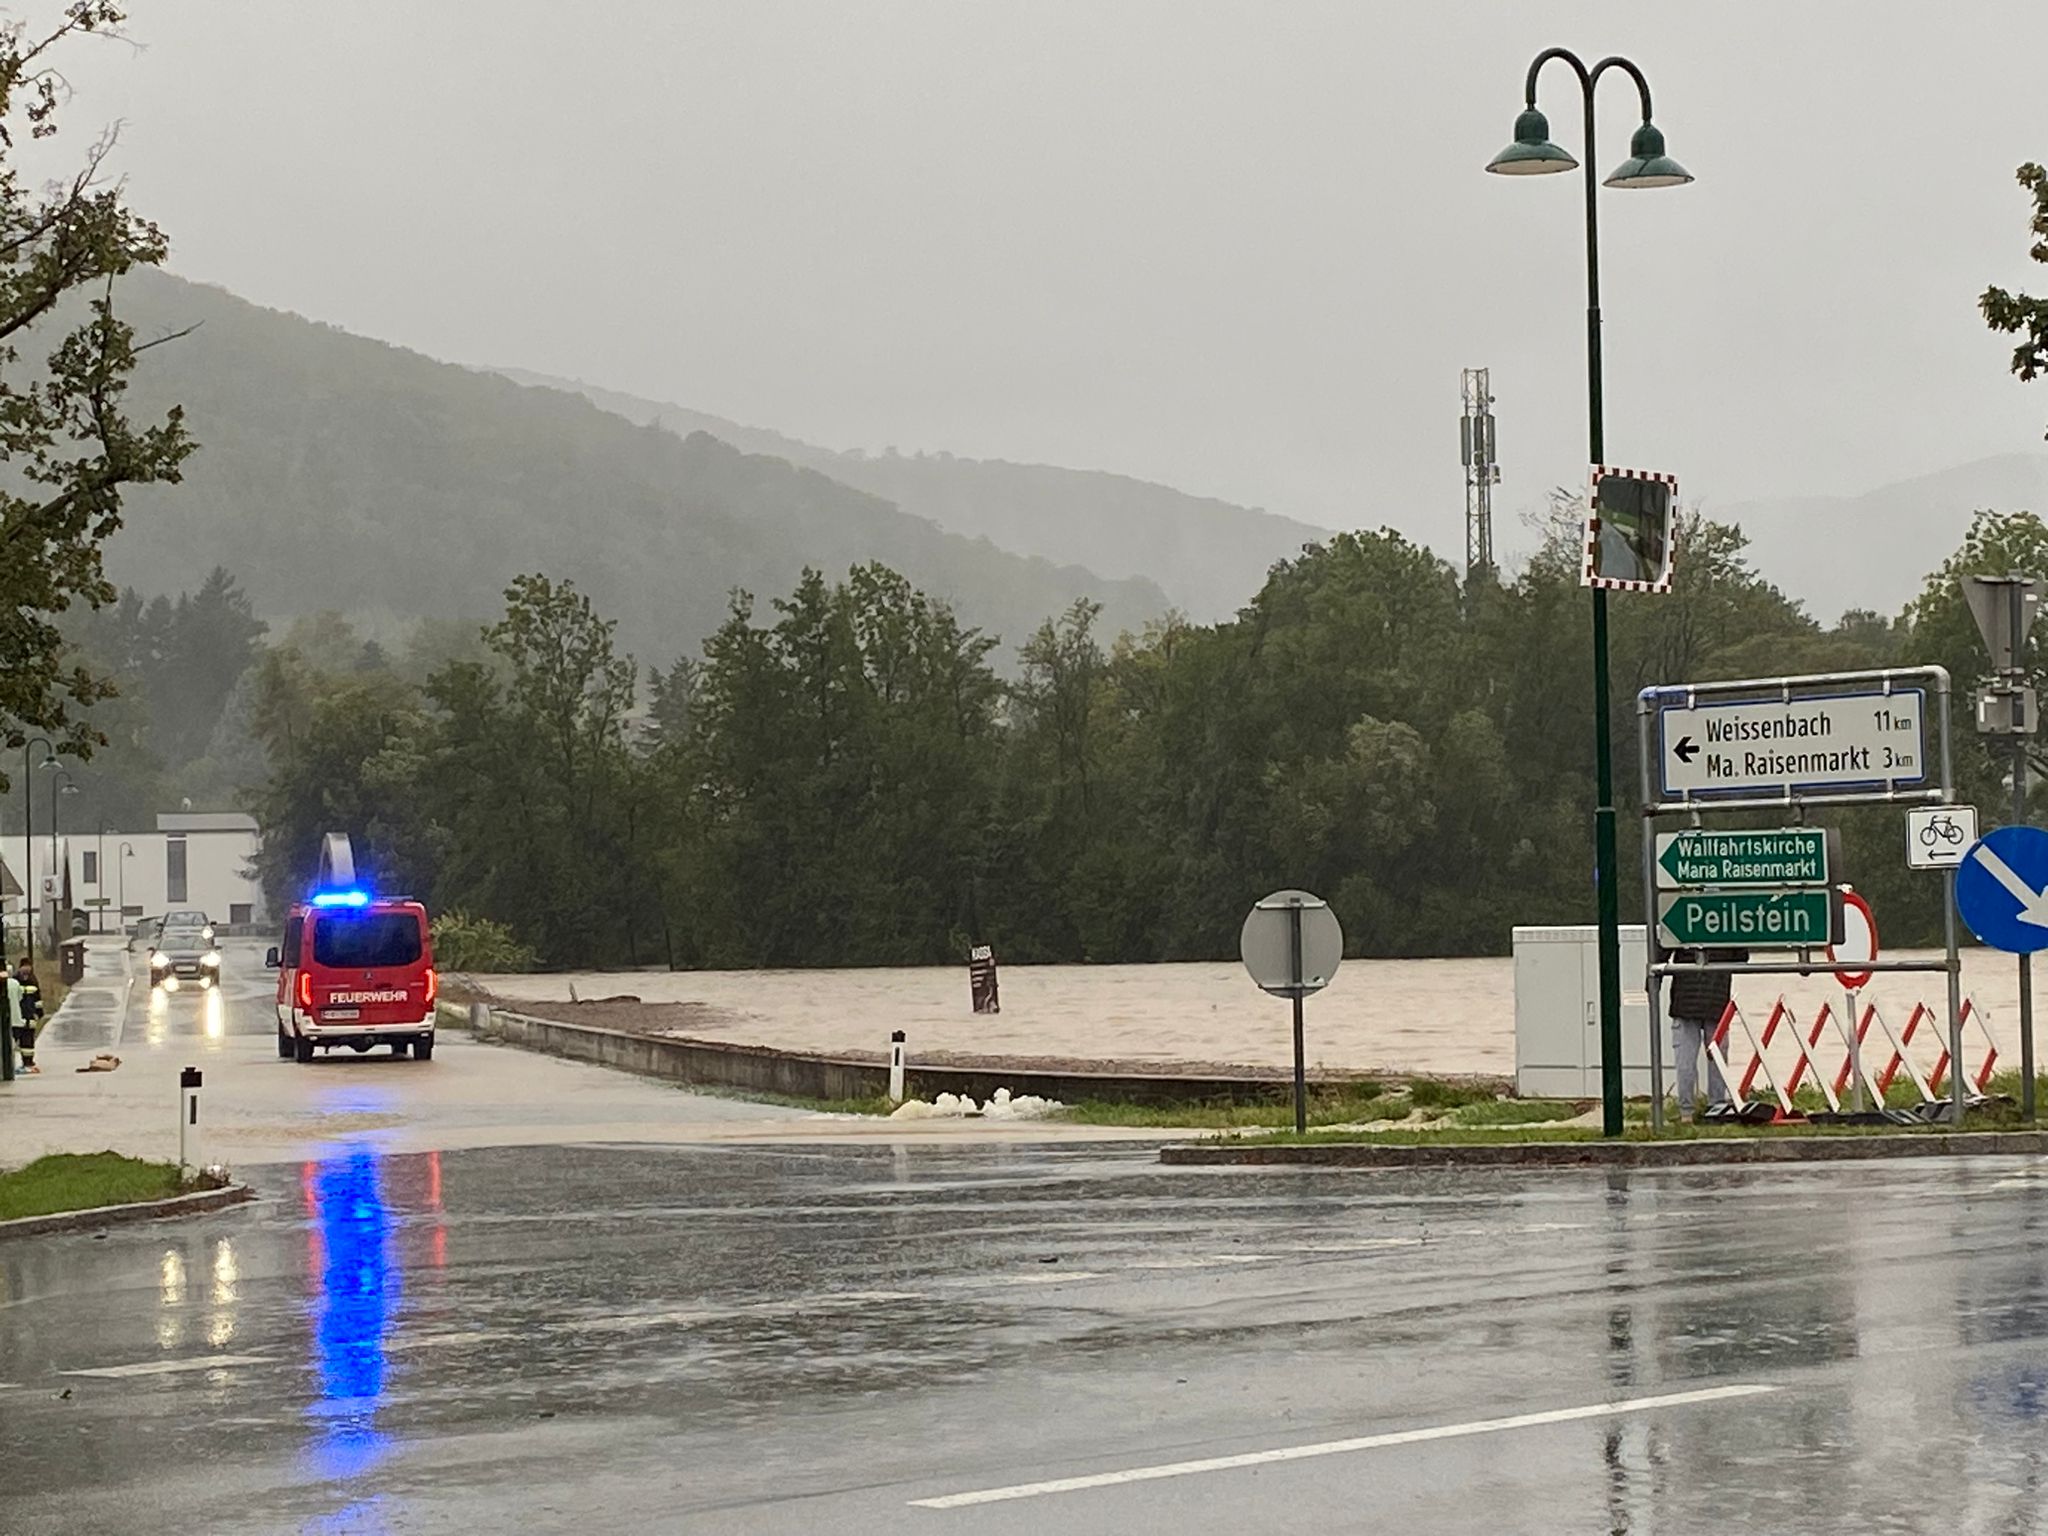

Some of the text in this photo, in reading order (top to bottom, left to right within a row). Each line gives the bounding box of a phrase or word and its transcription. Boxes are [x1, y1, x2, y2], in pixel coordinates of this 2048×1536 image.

[1707, 710, 1912, 742] Weissenbach 11 km
[1707, 745, 1913, 778] Ma. Raisenmarkt 3 km
[1678, 836, 1816, 857] Wallfahrtskirche
[1678, 858, 1816, 879] Maria Raisenmarkt
[1687, 901, 1810, 934] Peilstein
[330, 990, 408, 1004] FEUERWEHR
